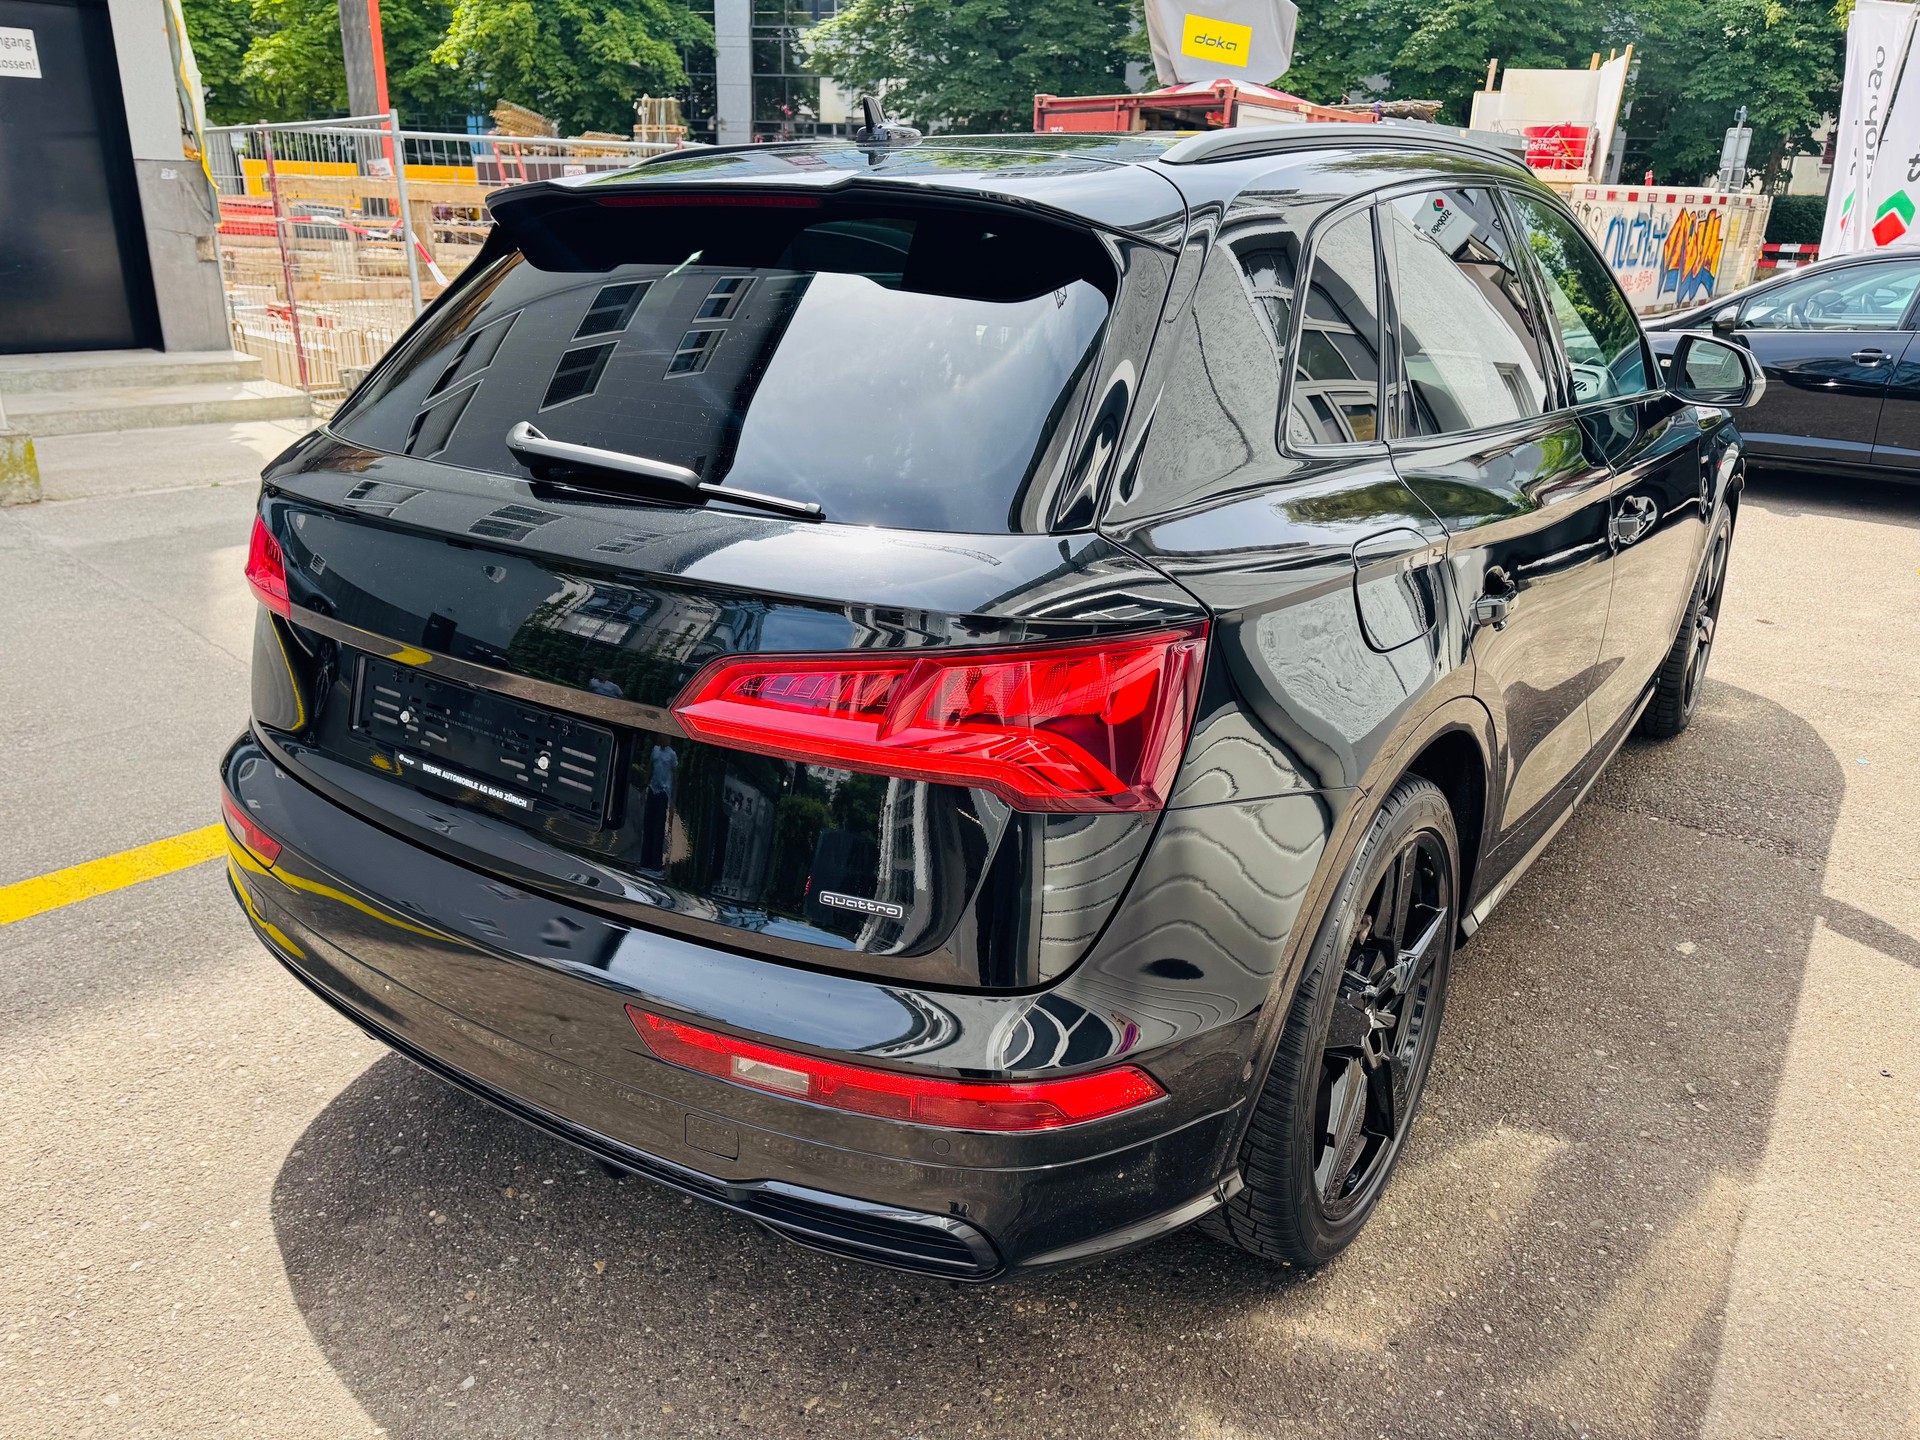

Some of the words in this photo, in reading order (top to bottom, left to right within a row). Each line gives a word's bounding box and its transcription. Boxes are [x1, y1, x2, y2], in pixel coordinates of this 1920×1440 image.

[1194, 33, 1238, 51] doka
[0, 59, 37, 70] ossen!
[422, 763, 442, 777] WESPE
[442, 770, 479, 790] AUTOMOBILE
[479, 784, 488, 794] AG
[488, 787, 504, 799] 8048
[504, 793, 528, 808] ZÜRICH
[822, 894, 899, 916] quattro
